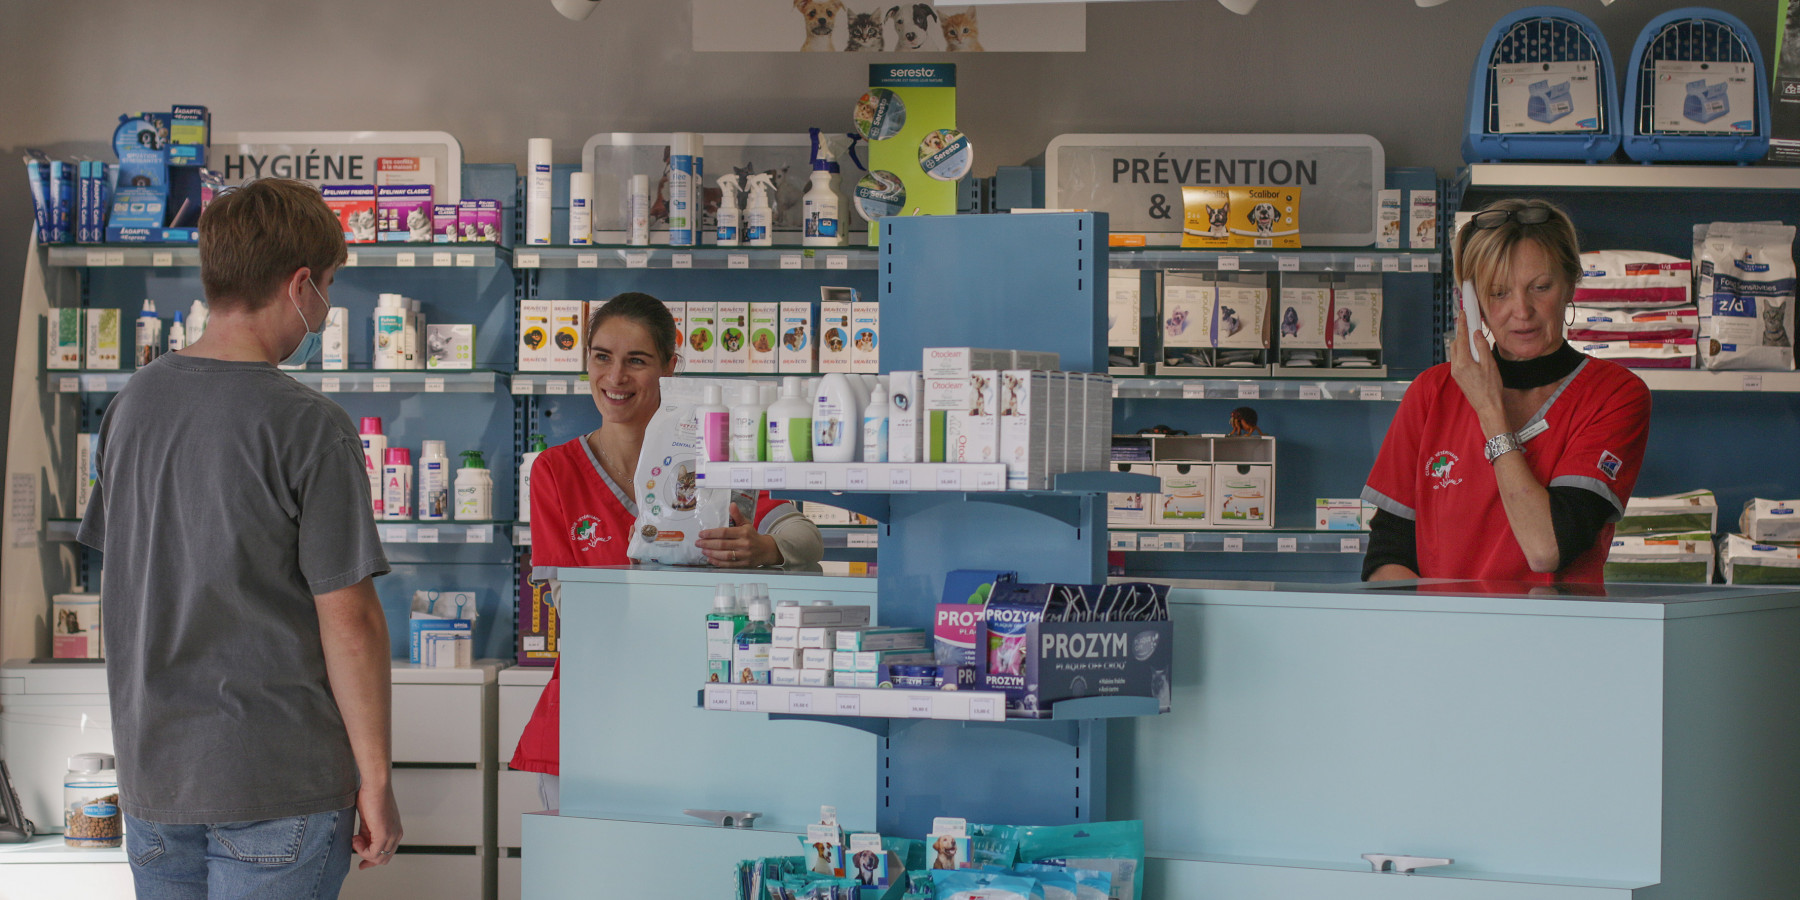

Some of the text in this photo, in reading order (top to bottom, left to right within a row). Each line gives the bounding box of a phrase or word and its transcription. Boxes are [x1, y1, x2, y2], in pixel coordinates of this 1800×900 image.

[889, 68, 936, 77] seresto
[872, 98, 888, 126] Seresto
[933, 142, 961, 162] Seresto
[224, 148, 364, 180] HYGIÉNE
[1111, 152, 1318, 185] PRÉVENTION
[1248, 190, 1280, 199] Scalibor
[1148, 193, 1172, 220] &
[1737, 283, 1777, 292] ensitivities
[1720, 297, 1744, 312] z/d
[389, 477, 399, 487] A
[938, 610, 984, 626] PROZ
[986, 609, 1041, 622] PROZYM
[1042, 632, 1128, 658] PROZYM
[986, 676, 1024, 686] PROZYM
